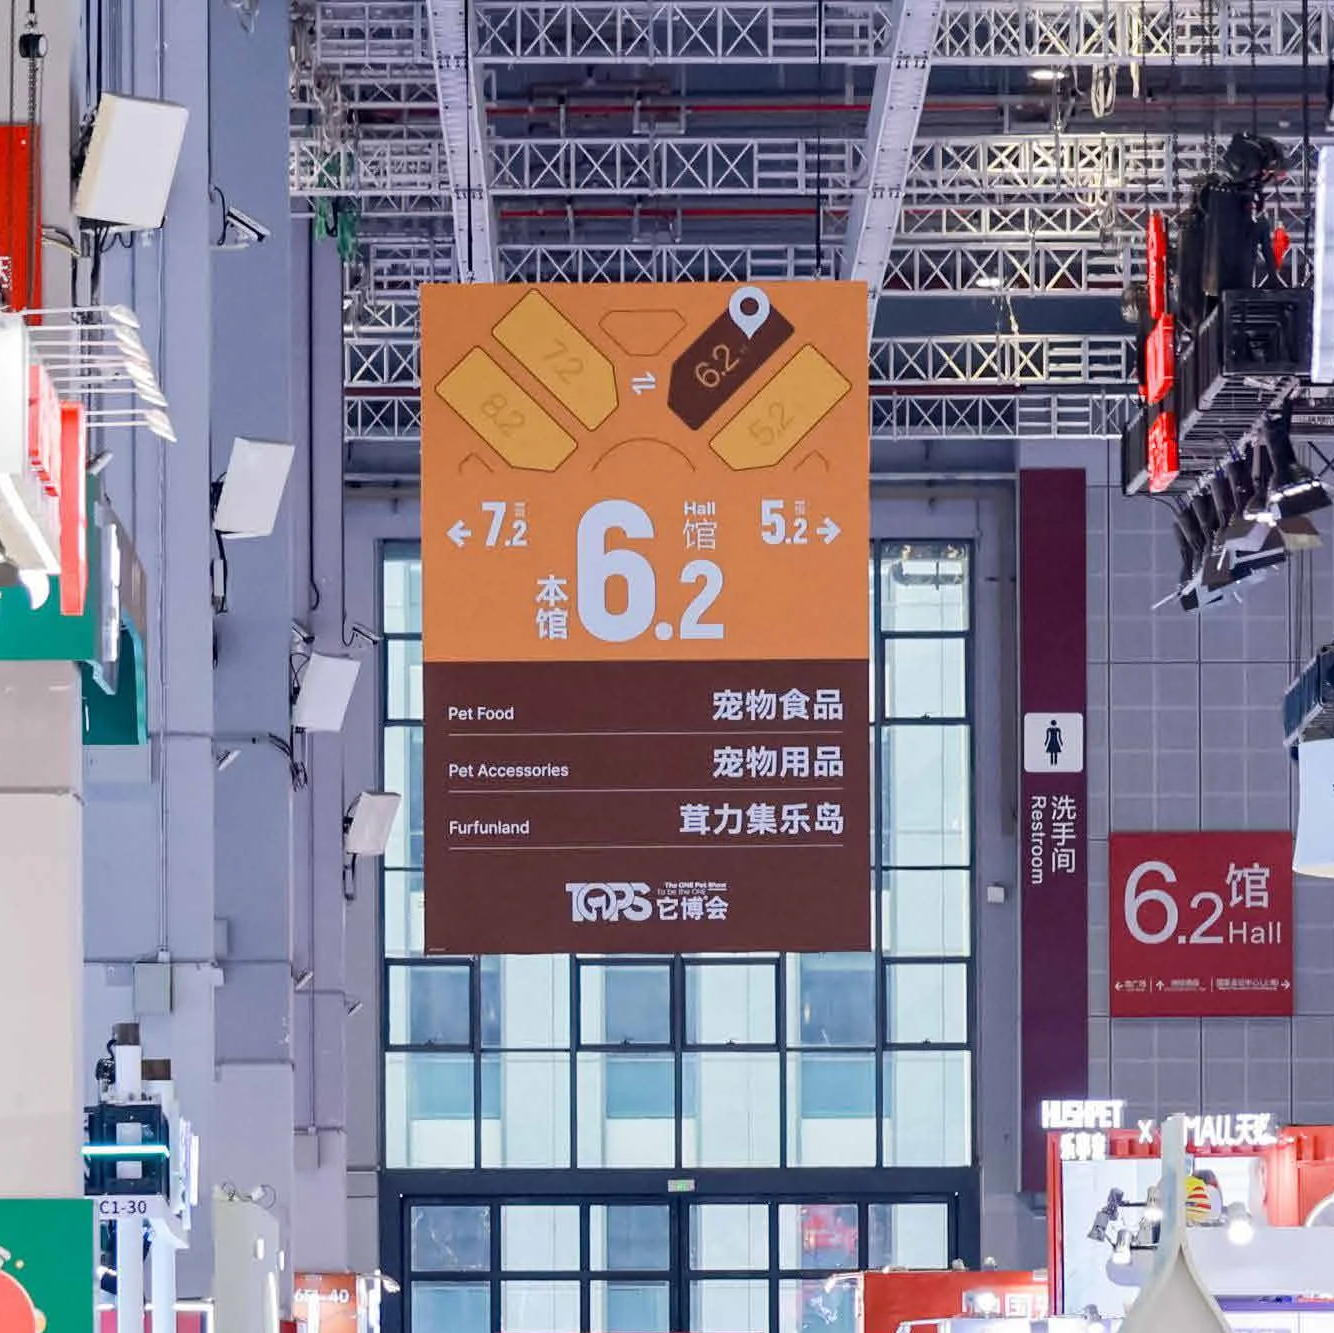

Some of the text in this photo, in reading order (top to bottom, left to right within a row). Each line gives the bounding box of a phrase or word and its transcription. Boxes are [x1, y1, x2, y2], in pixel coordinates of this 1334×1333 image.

[695, 344, 740, 388] 6.2
[481, 501, 528, 547] 7.2
[683, 501, 716, 515] Hall
[761, 499, 808, 545] 5.2
[682, 519, 717, 551] 馆
[576, 499, 725, 644] 6.2
[535, 575, 569, 641] 本馆
[448, 706, 515, 721] Pet Food
[712, 688, 844, 722] 宠物食品
[448, 763, 569, 778] Pet Accessories
[712, 745, 844, 779] 宠物用品
[448, 820, 530, 835] Furfunland
[679, 802, 844, 836] 茸力集乐岛
[1050, 795, 1076, 873] 洗手间
[1031, 796, 1047, 885] Restroom
[1123, 861, 1224, 945] 6.2
[1225, 863, 1270, 909] 馆
[656, 896, 729, 920] 它博会
[1228, 921, 1282, 945] Hall
[99, 1200, 147, 1215] C1-30
